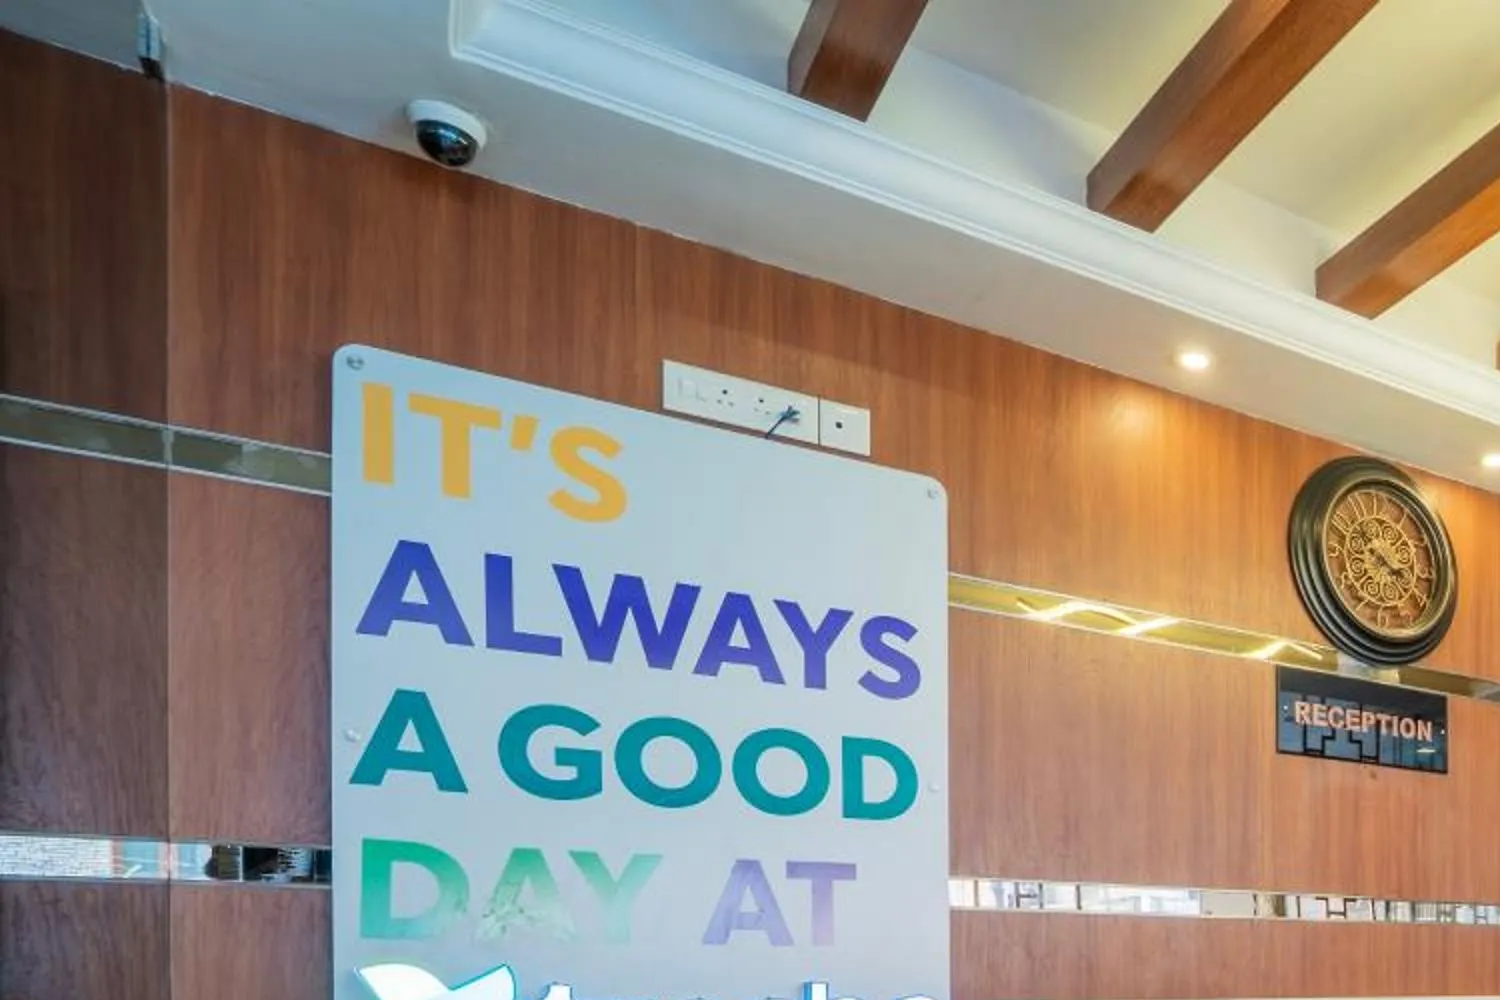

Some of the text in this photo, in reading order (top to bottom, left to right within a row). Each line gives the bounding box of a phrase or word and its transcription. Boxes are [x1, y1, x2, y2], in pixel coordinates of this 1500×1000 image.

[361, 382, 628, 524] IT'S
[355, 539, 922, 701] ALWAYS
[349, 688, 919, 821] A GOOD
[1294, 701, 1433, 742] RECEPTION
[358, 838, 857, 947] DAY AT
